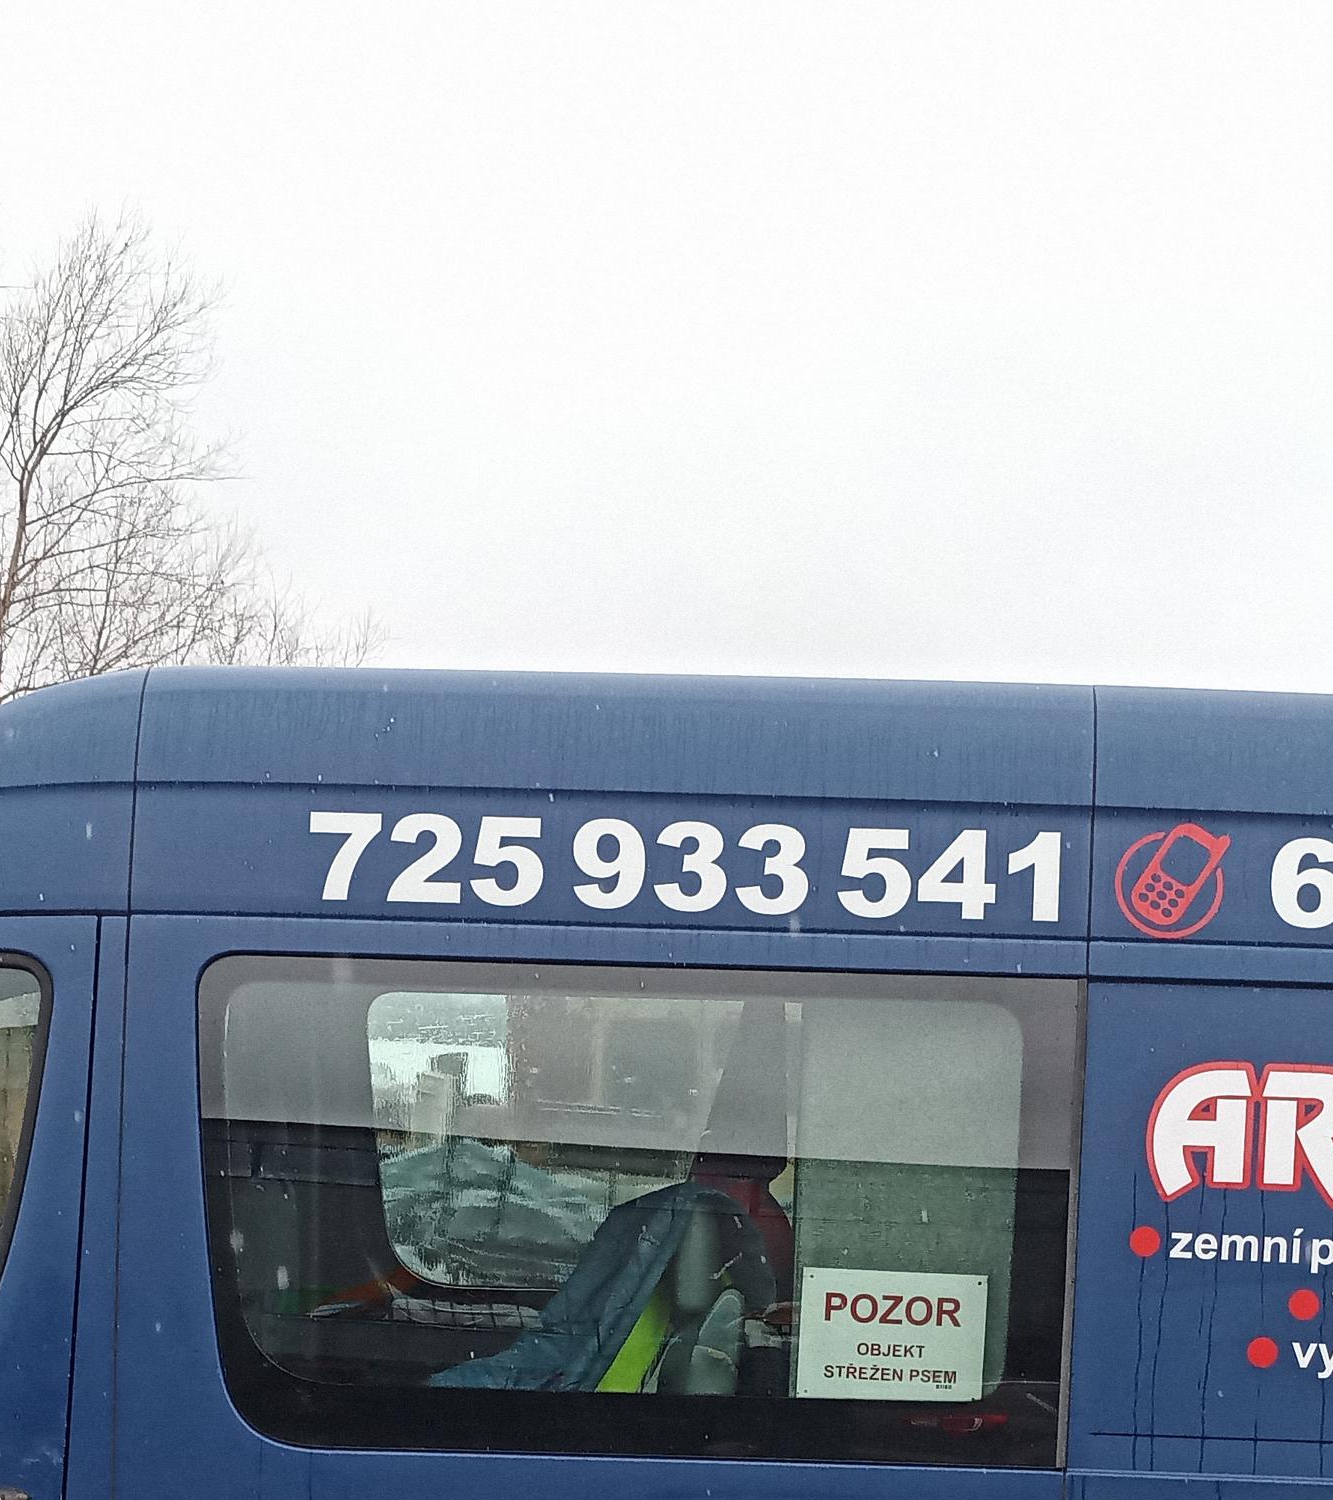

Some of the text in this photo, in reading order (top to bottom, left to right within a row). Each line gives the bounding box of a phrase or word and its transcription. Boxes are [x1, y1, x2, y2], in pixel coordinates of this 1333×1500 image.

[309, 811, 1062, 923] 725 933 541
[1169, 1228, 1304, 1264] zemní
[824, 1291, 962, 1328] POZOR
[857, 1342, 925, 1358] OBJEKT
[823, 1363, 957, 1384] STŘEŽEN PSEM
